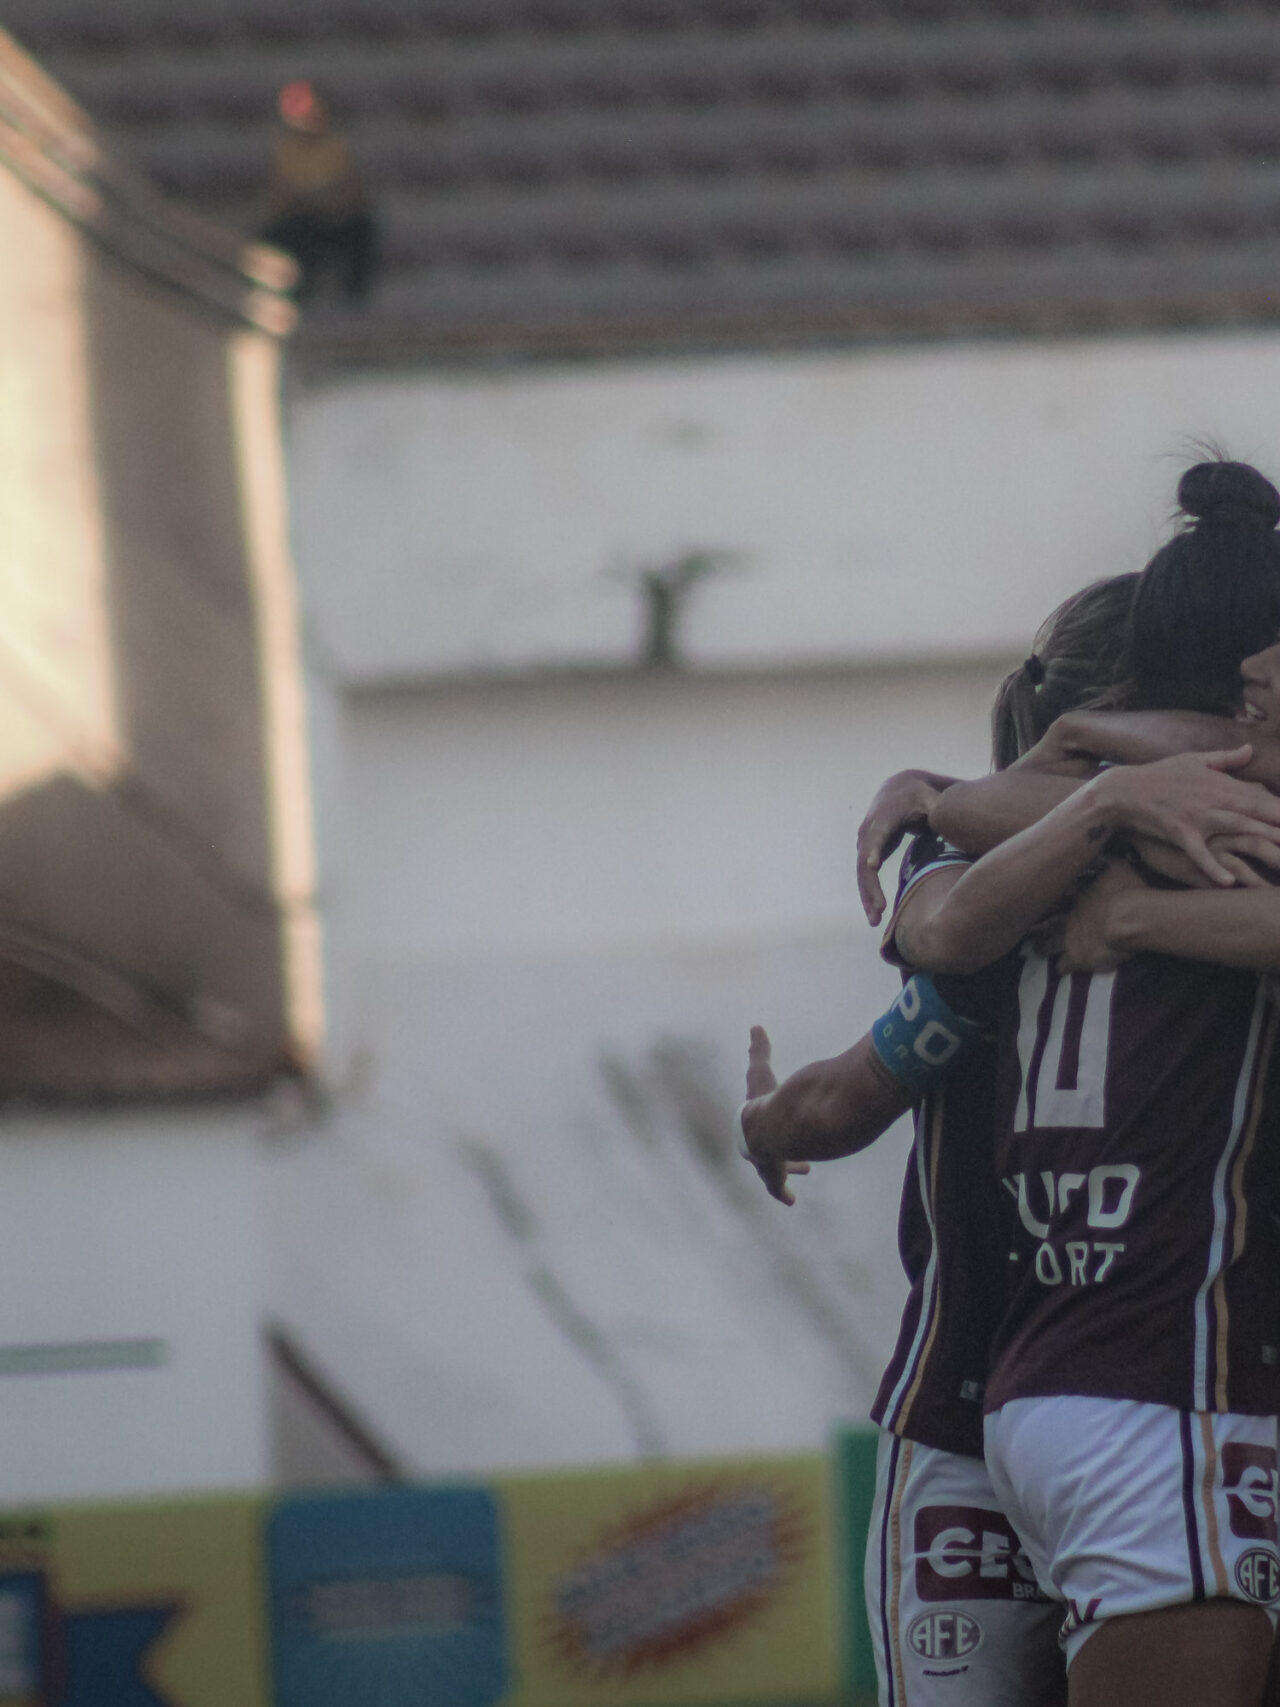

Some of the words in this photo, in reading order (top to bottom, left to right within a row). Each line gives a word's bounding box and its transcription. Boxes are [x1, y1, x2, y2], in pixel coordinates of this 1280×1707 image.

[1013, 946, 1118, 1133] 10
[1008, 1241, 1126, 1287] ORT
[1239, 1554, 1280, 1598] AFE
[912, 1613, 974, 1658] AFE
